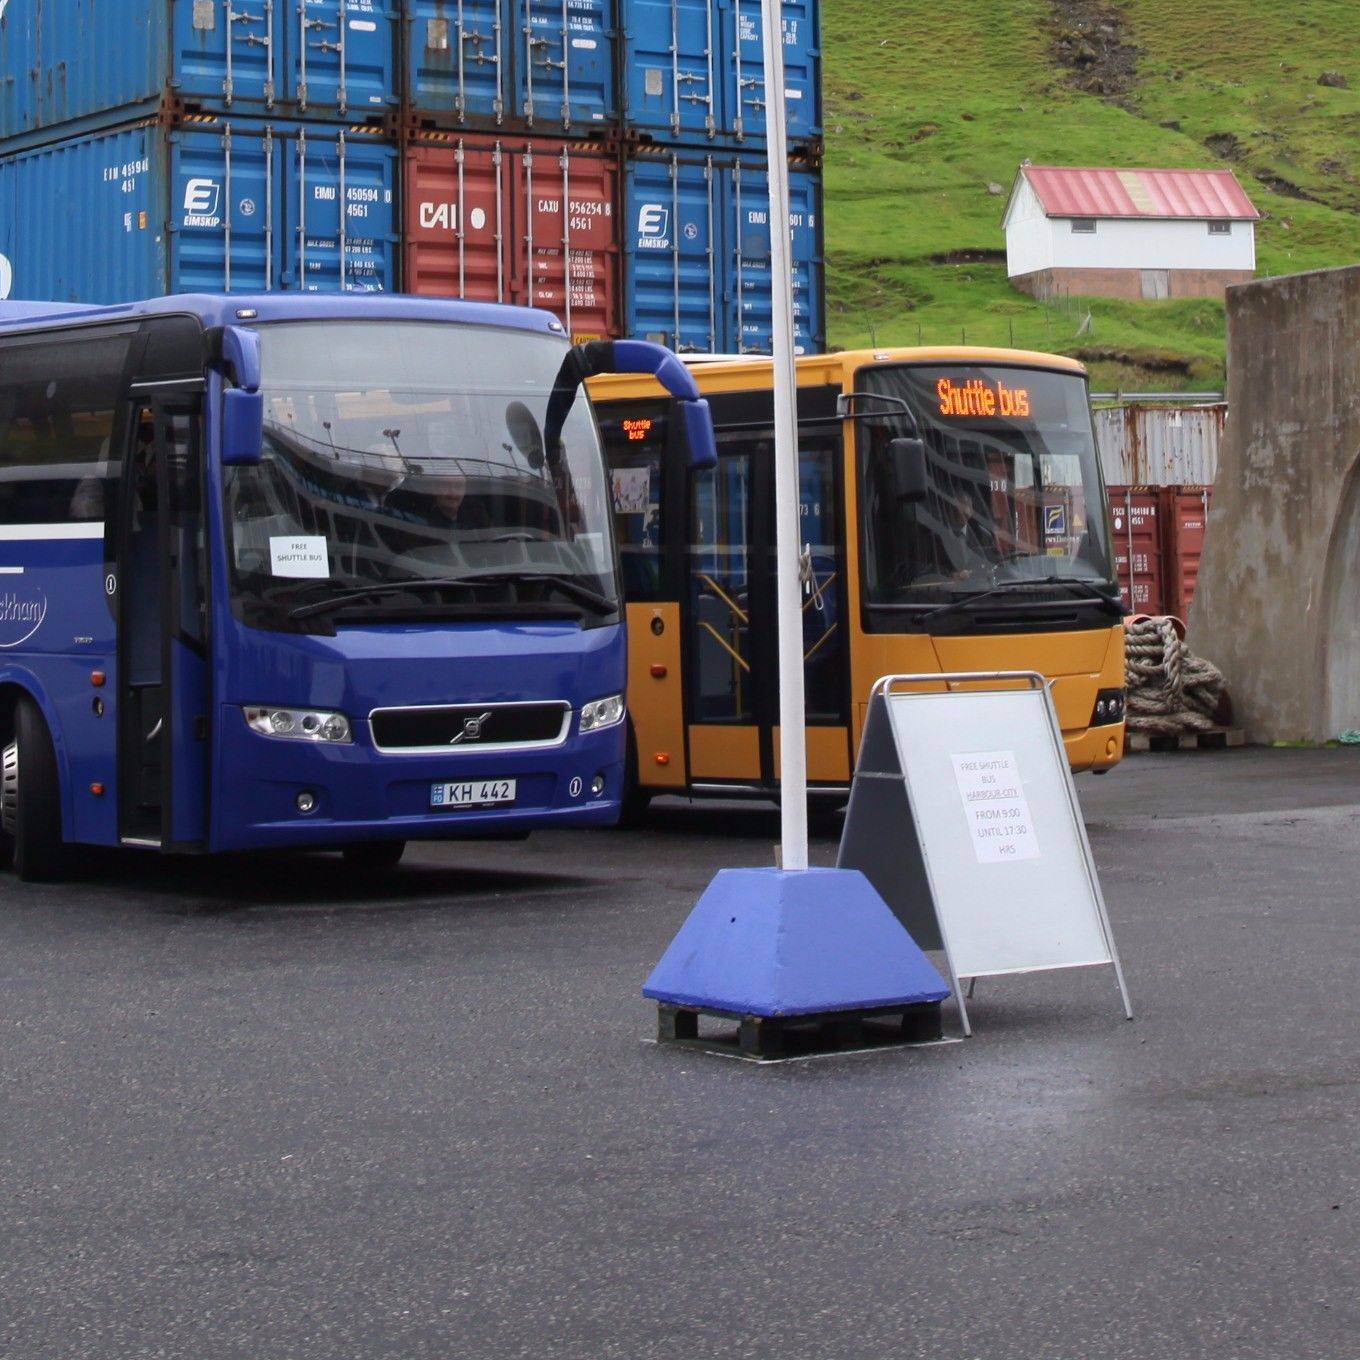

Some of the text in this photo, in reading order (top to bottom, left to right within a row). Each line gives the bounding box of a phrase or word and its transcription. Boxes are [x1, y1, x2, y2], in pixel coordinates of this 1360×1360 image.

[314, 186, 336, 200] EIMU
[346, 204, 368, 217] 45G1
[538, 200, 611, 216] CAXU 956254 8
[183, 215, 220, 228] EIMSKIP
[420, 202, 456, 230] CAI
[748, 211, 767, 224] EIMU
[570, 217, 592, 230] 45G1
[638, 238, 669, 249] EIMSKIP
[937, 379, 1030, 416] Shuttle bus
[622, 419, 652, 431] Shuttle
[629, 430, 645, 440] bus
[277, 554, 323, 562] SHUTTLE BUS
[960, 760, 1009, 771] FREE SHUTTLE
[981, 775, 996, 784] BUS
[449, 785, 472, 801] KH
[480, 782, 509, 799] 442
[975, 810, 1001, 820] FROM
[977, 826, 1003, 838] UNTIL
